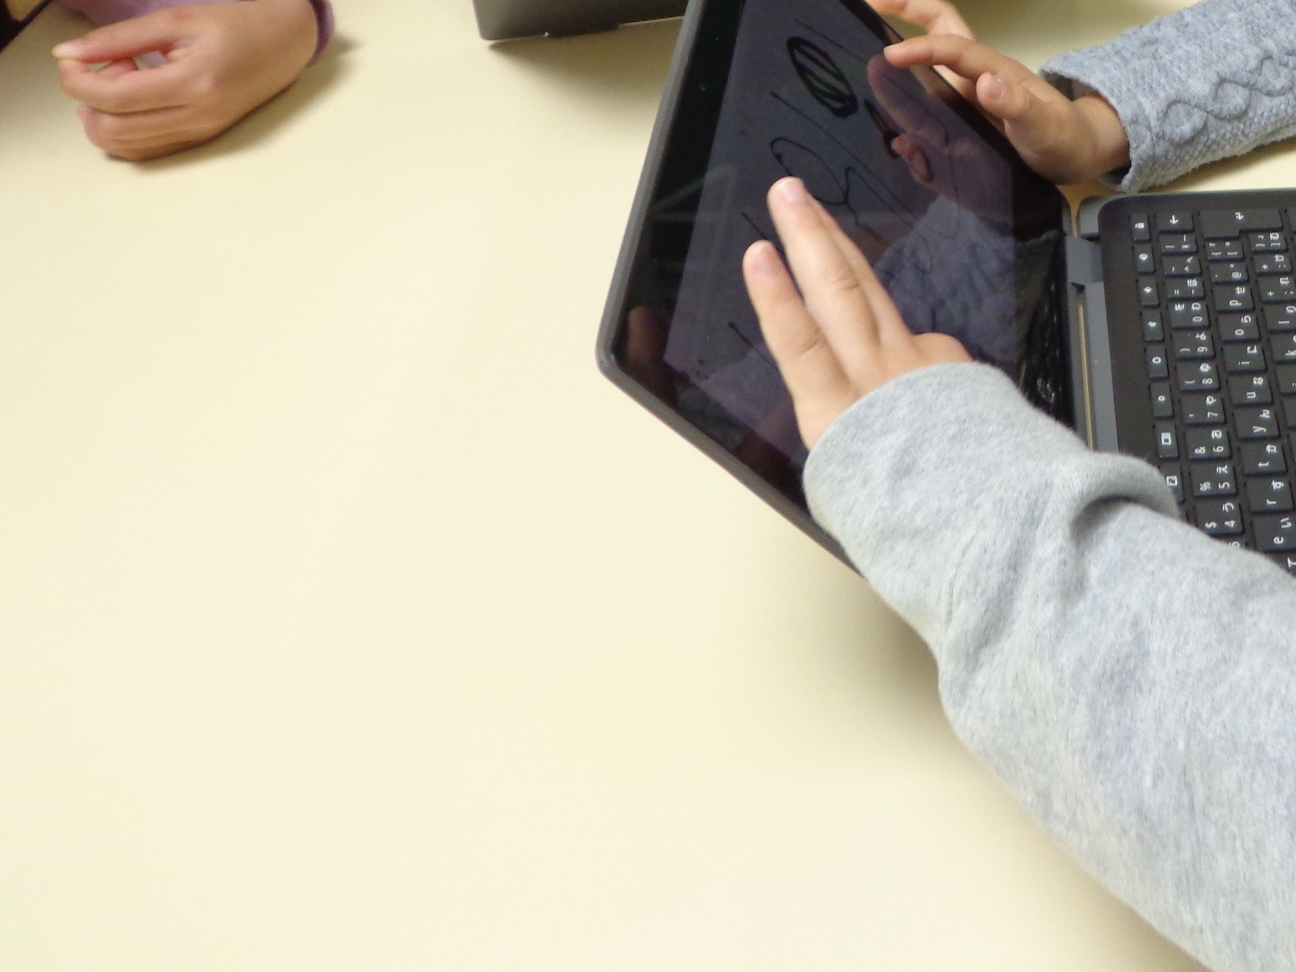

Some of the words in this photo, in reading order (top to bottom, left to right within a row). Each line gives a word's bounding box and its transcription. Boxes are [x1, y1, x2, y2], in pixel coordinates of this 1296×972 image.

[1229, 299, 1242, 307] p
[1285, 349, 1296, 357] k
[1246, 391, 1256, 399] u
[1207, 411, 1219, 419] 7
[1212, 445, 1226, 454] 6
[1218, 481, 1230, 489] 5
[1224, 520, 1236, 529] 4
[1273, 536, 1284, 545] e
[1280, 517, 1292, 528] い
